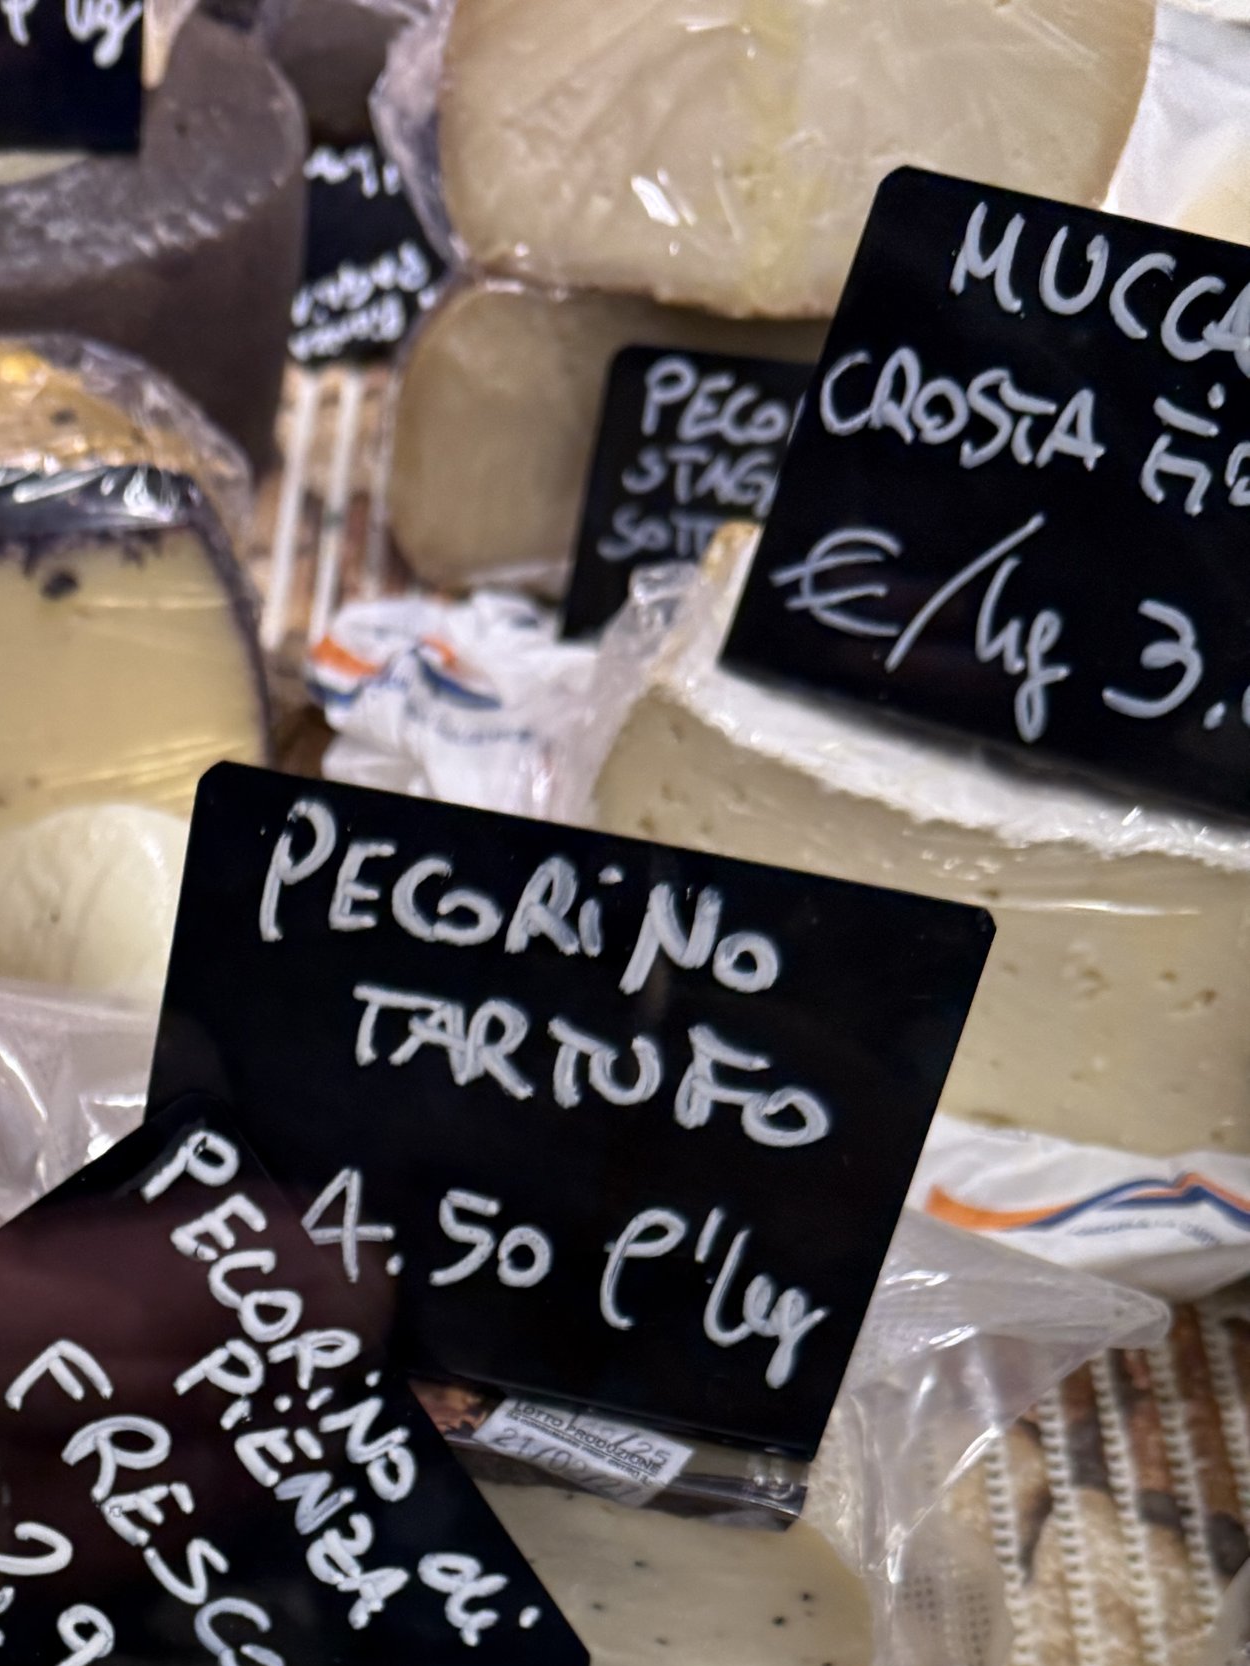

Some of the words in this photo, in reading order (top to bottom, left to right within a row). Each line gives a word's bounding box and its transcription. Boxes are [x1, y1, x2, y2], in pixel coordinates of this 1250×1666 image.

[641, 355, 805, 446] PECO
[821, 348, 1105, 470] CROSTA
[1102, 599, 1250, 729] 3.
[353, 982, 833, 1148] TARTUFO
